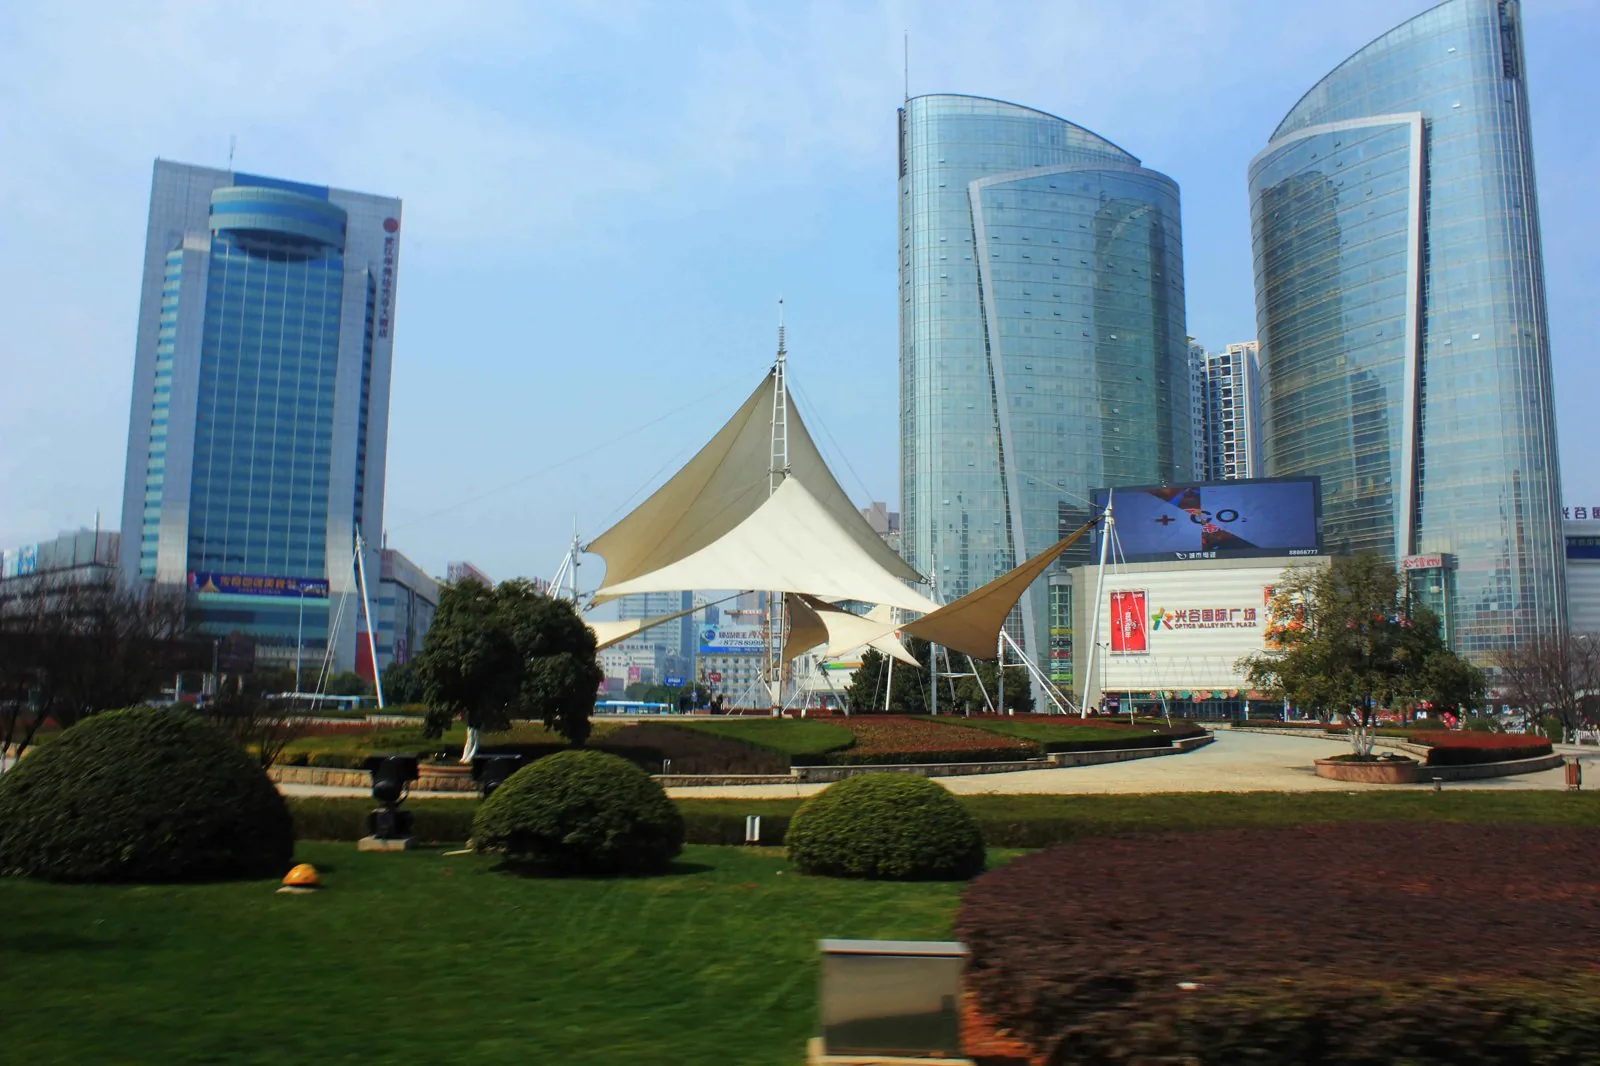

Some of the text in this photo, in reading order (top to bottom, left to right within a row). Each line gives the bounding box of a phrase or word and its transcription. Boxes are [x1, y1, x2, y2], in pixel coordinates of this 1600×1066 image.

[1174, 608, 1256, 622] 光谷国际广场
